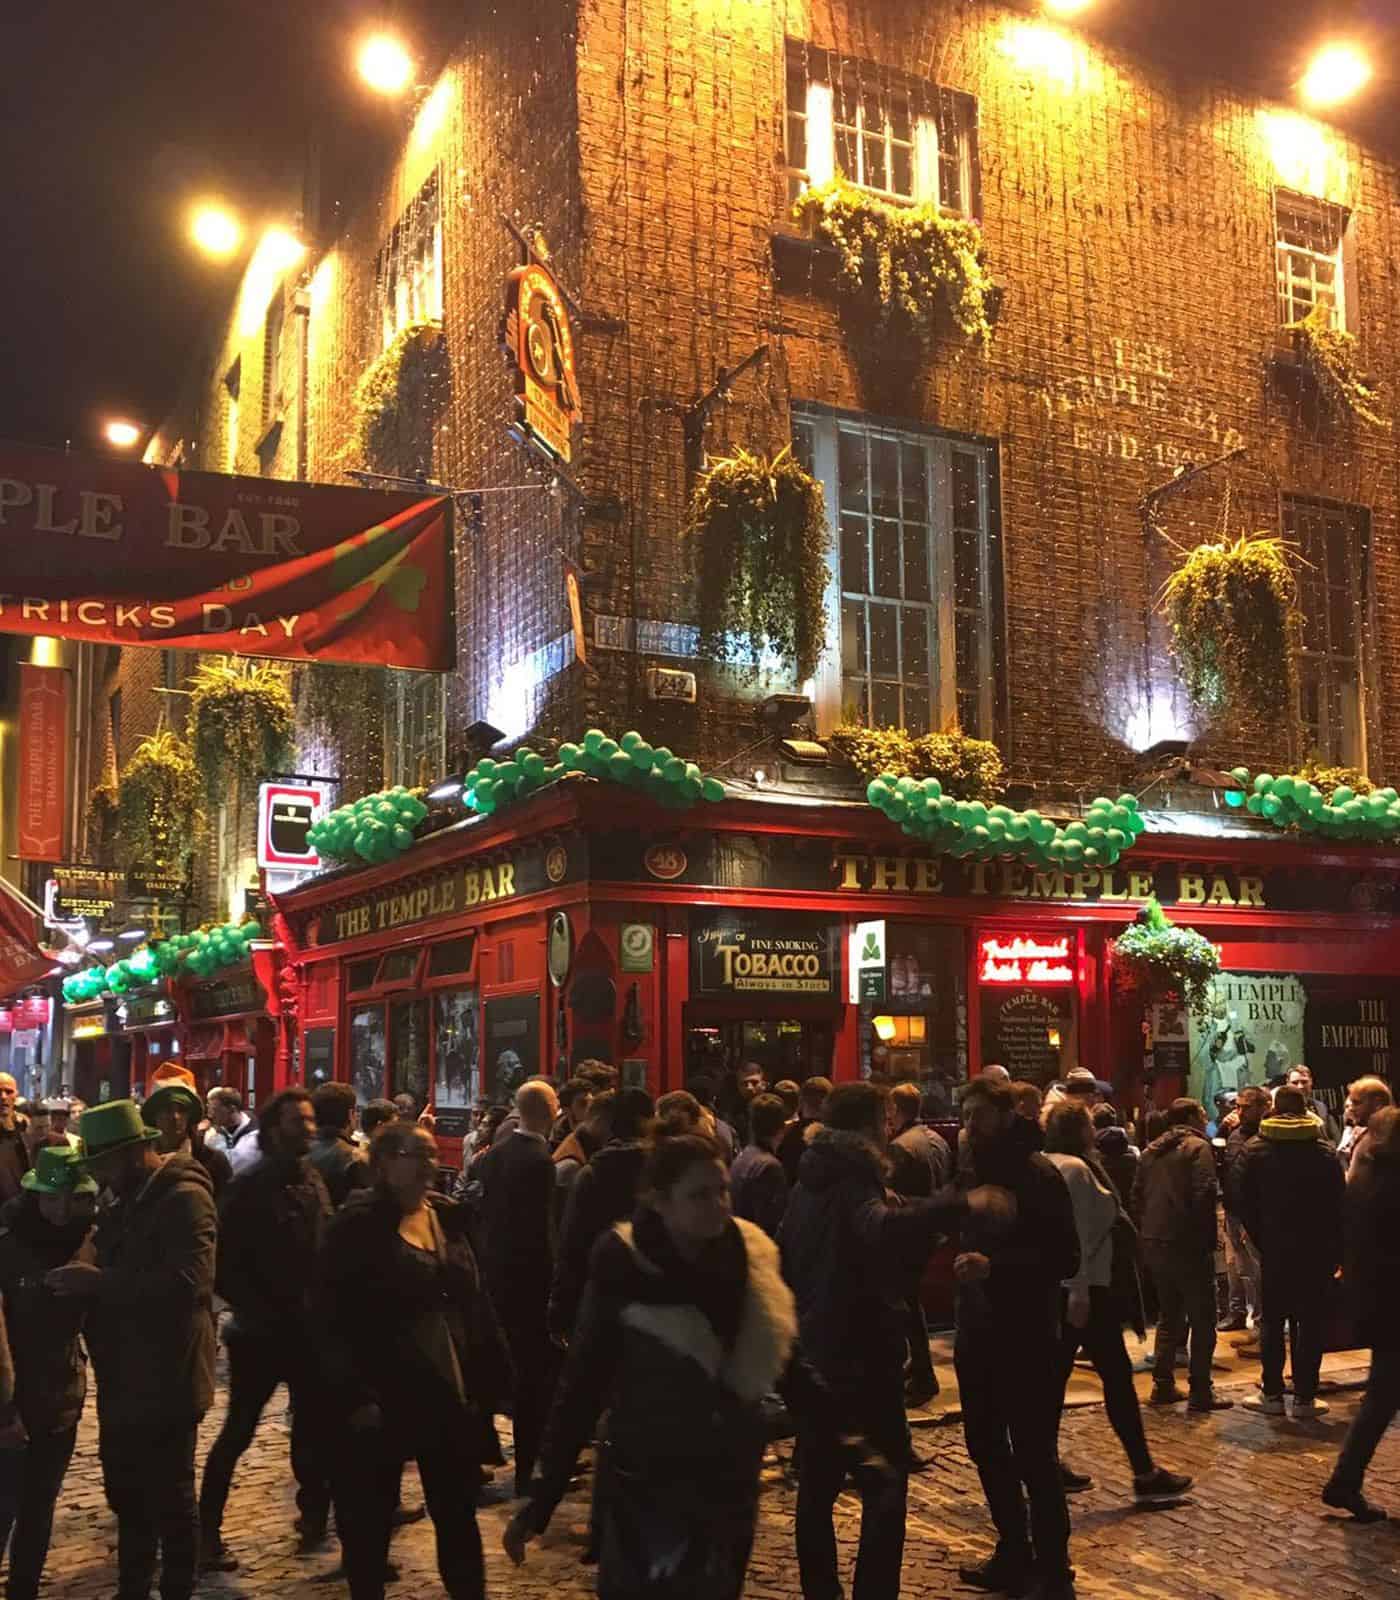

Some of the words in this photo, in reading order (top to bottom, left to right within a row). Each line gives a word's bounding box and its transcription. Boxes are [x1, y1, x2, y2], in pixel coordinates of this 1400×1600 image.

[164, 502, 305, 556] BAR
[202, 603, 299, 637] DAY
[831, 854, 944, 893] THE
[963, 858, 1157, 901] TEMPLE
[1176, 872, 1267, 907] BAR
[336, 905, 371, 938] THE
[376, 880, 456, 929] TEMPLE
[465, 863, 516, 905] BAR
[751, 939, 773, 949] FINE
[775, 940, 819, 951] SMOKING
[717, 945, 820, 984] TOBACCO
[1226, 983, 1298, 1001] TEMPLE
[1248, 1003, 1285, 1023] BAR
[1320, 1025, 1389, 1049] EMPEROR
